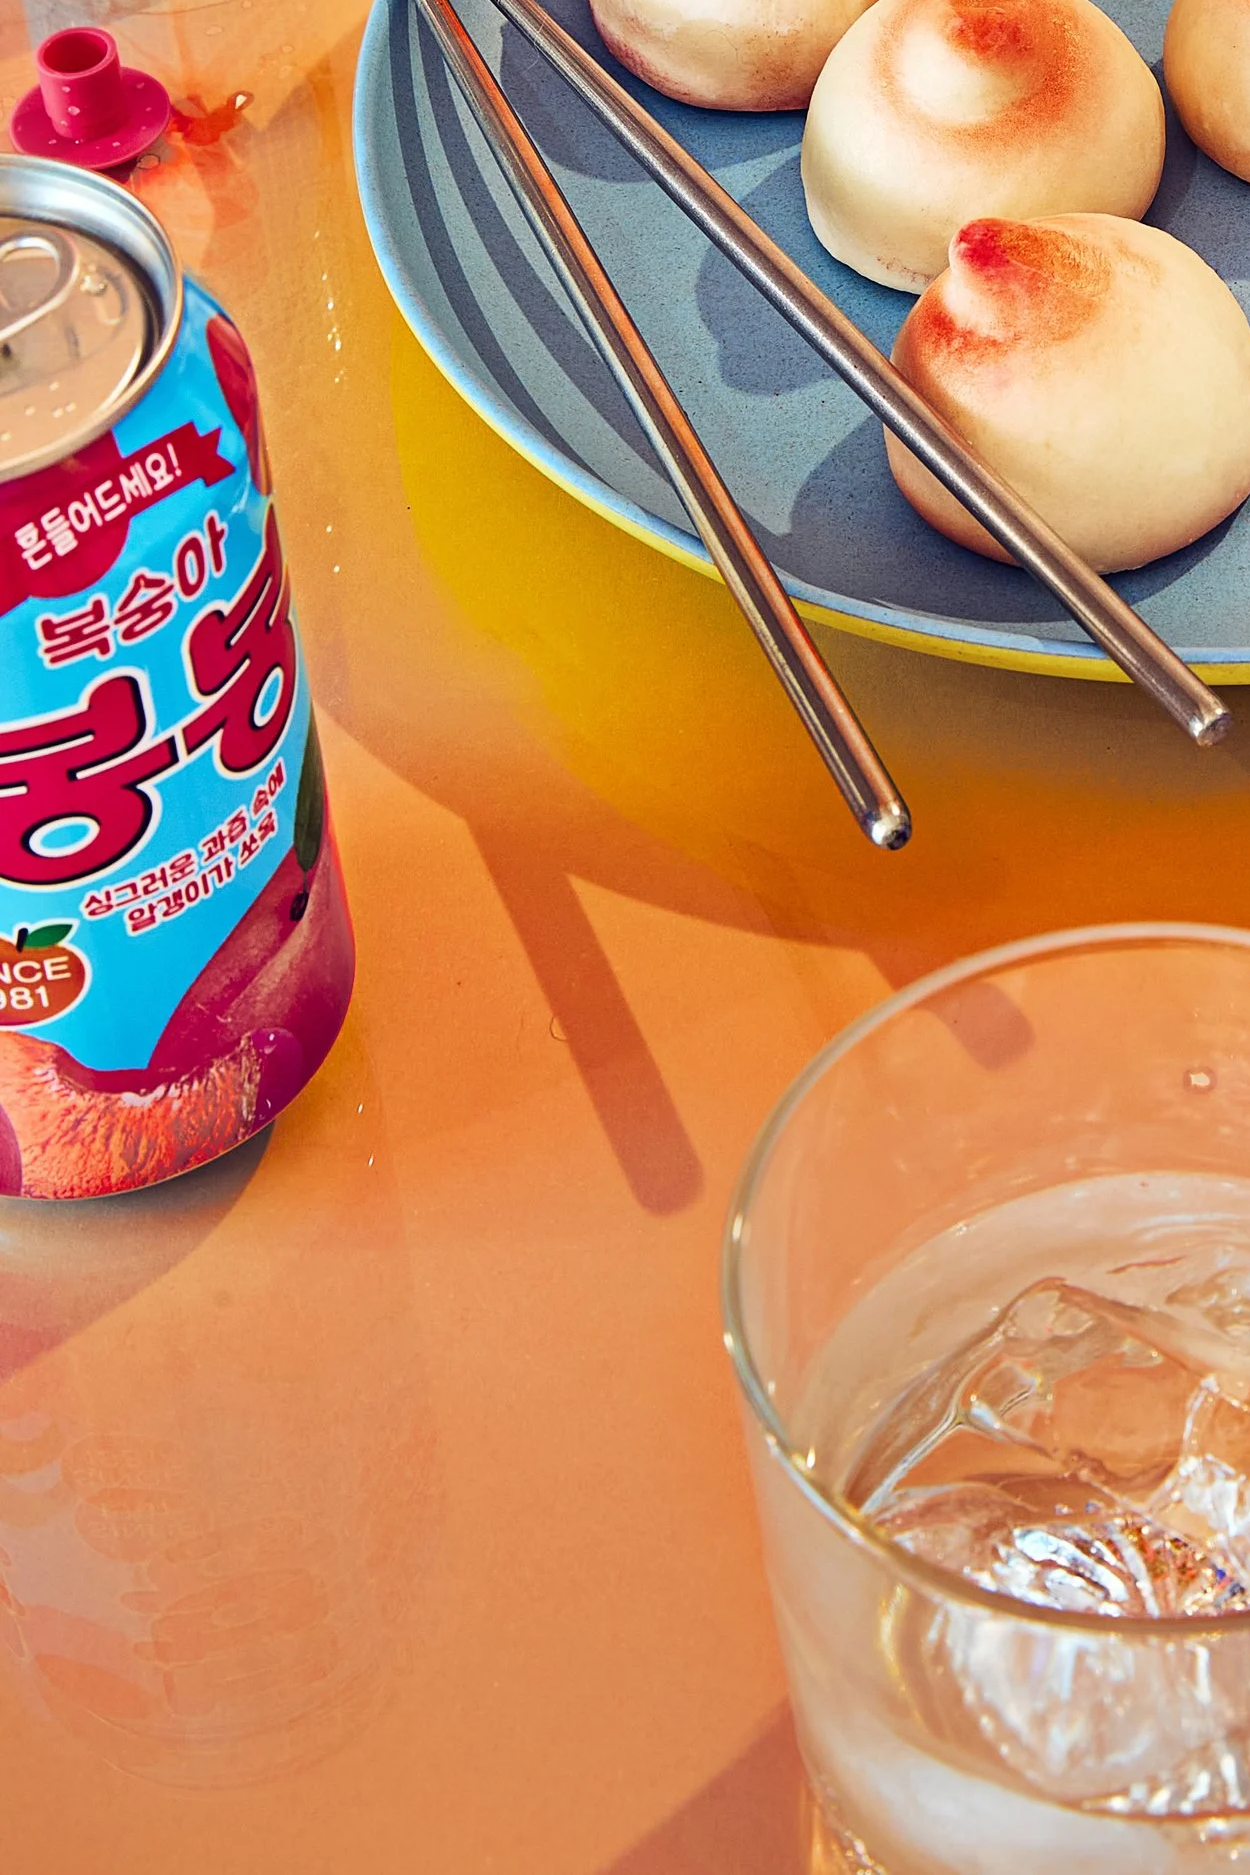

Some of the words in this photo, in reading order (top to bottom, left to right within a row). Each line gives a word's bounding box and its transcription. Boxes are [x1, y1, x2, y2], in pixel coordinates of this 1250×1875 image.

[14, 442, 182, 571] 흔들어드세요!
[38, 513, 226, 666] 복숭아
[84, 852, 196, 918] 싱그러운
[252, 760, 286, 817] 속에
[127, 856, 234, 933] 알갱이가
